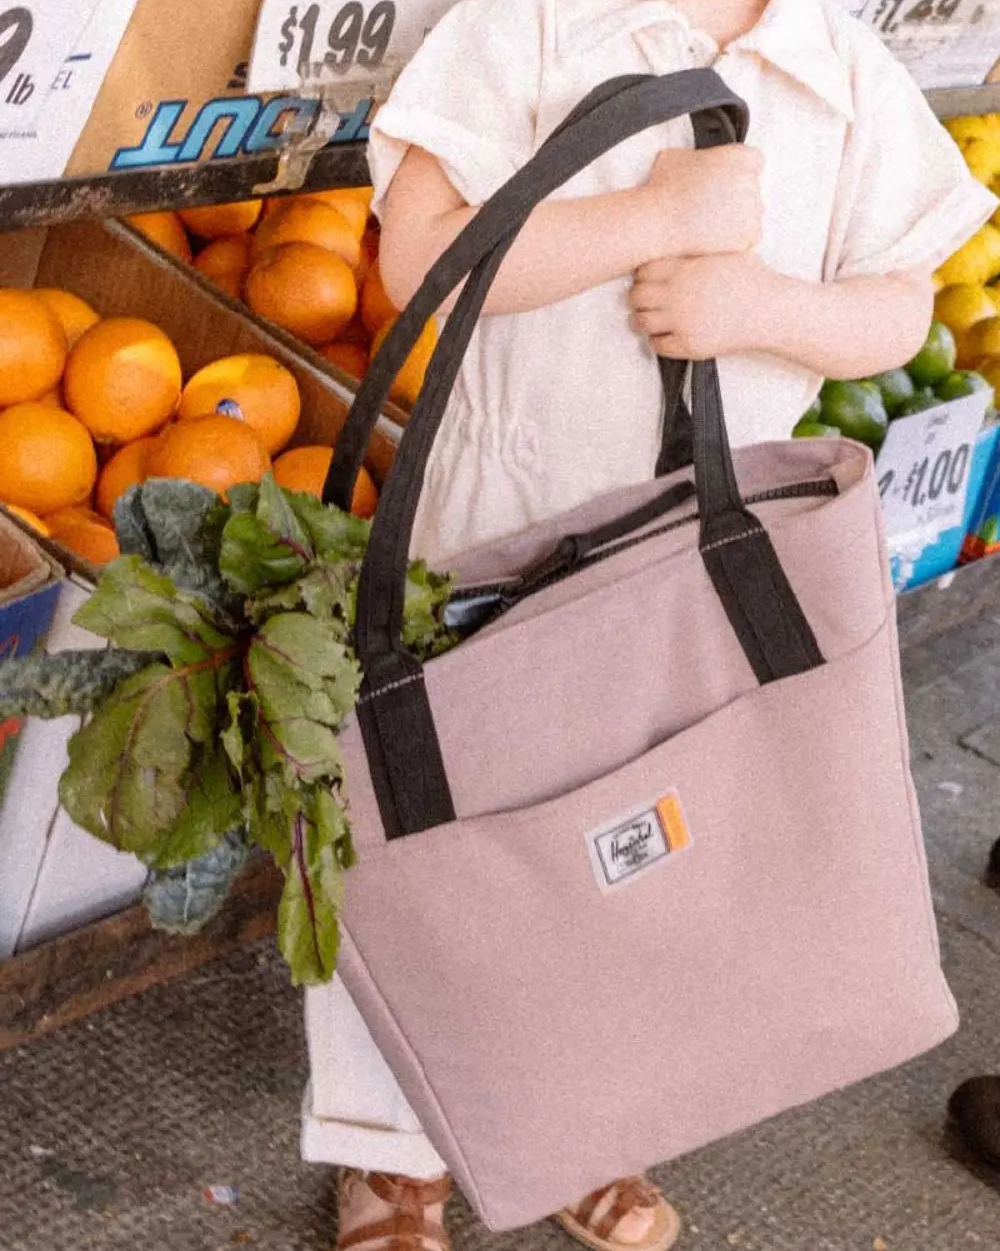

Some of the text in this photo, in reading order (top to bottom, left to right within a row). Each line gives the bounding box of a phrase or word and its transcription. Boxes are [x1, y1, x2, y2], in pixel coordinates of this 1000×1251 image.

[278, 0, 396, 78] $1.99
[6, 73, 35, 105] lb
[108, 96, 374, 171] OUT
